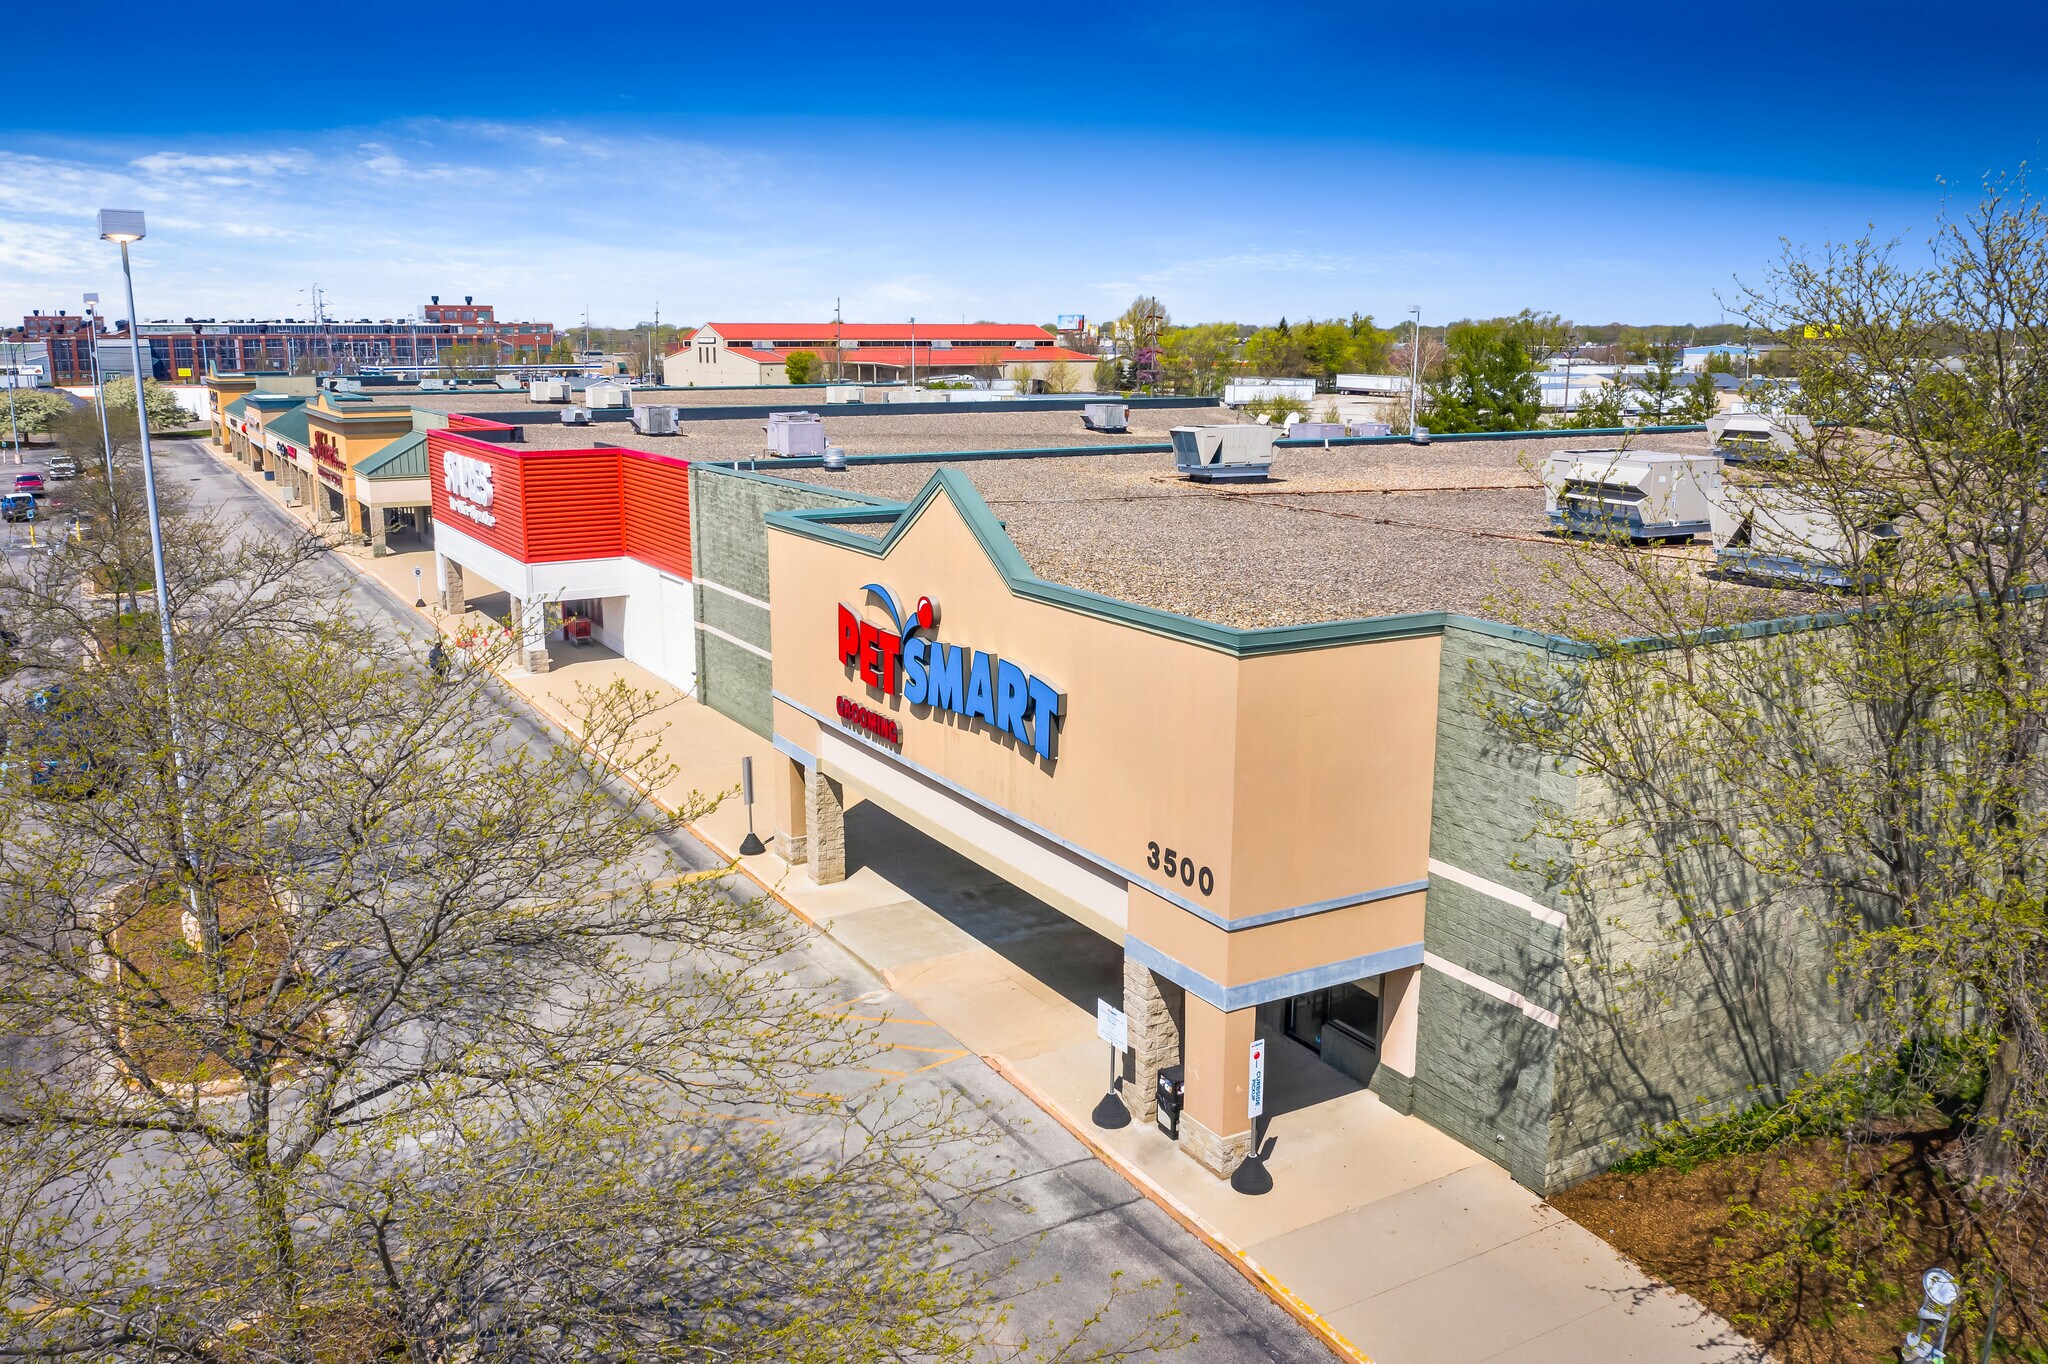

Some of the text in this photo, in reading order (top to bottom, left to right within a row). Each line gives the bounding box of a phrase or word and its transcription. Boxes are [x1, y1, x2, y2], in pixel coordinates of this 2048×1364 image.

[838, 601, 1064, 761] PETSMART
[836, 695, 901, 744] GROOMING
[1146, 841, 1214, 897] 3500
